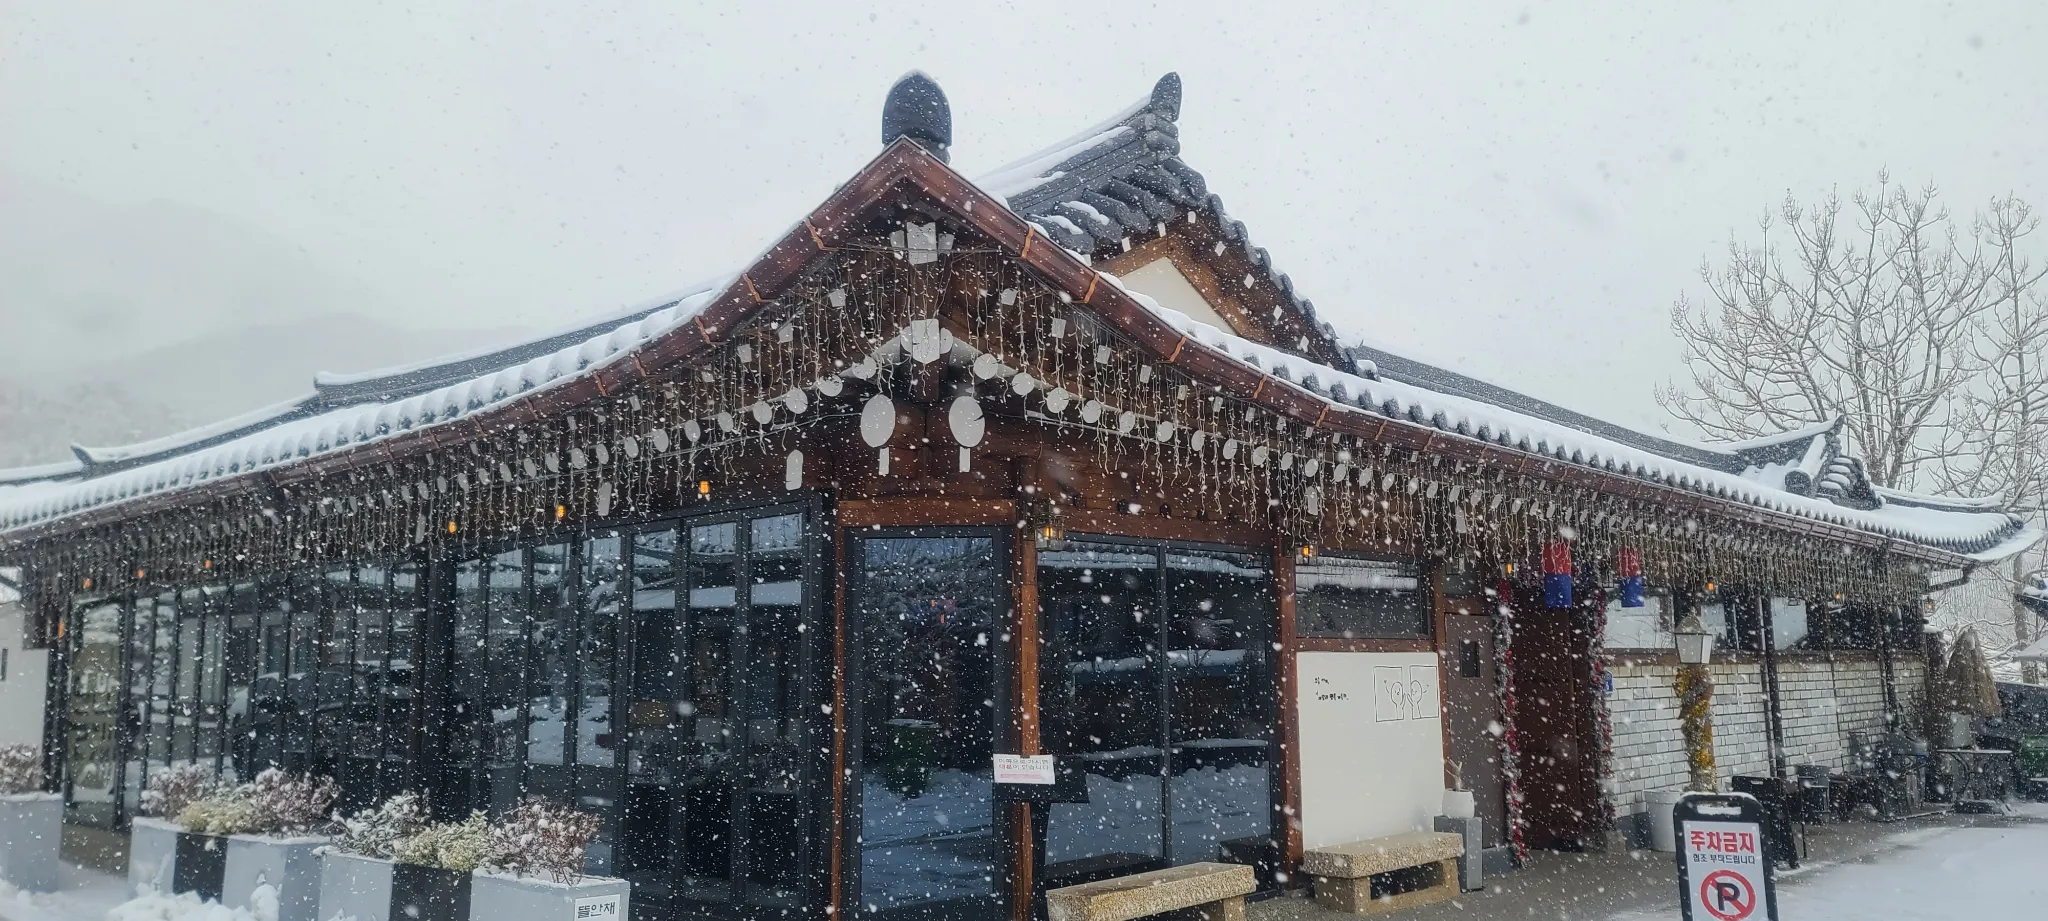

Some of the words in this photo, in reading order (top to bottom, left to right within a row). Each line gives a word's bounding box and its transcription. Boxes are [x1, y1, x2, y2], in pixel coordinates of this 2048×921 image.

[1690, 830, 1755, 853] 주차금지
[1693, 853, 1708, 863] 협조
[1710, 854, 1755, 865] 부탁드립니다
[1717, 882, 1740, 911] P
